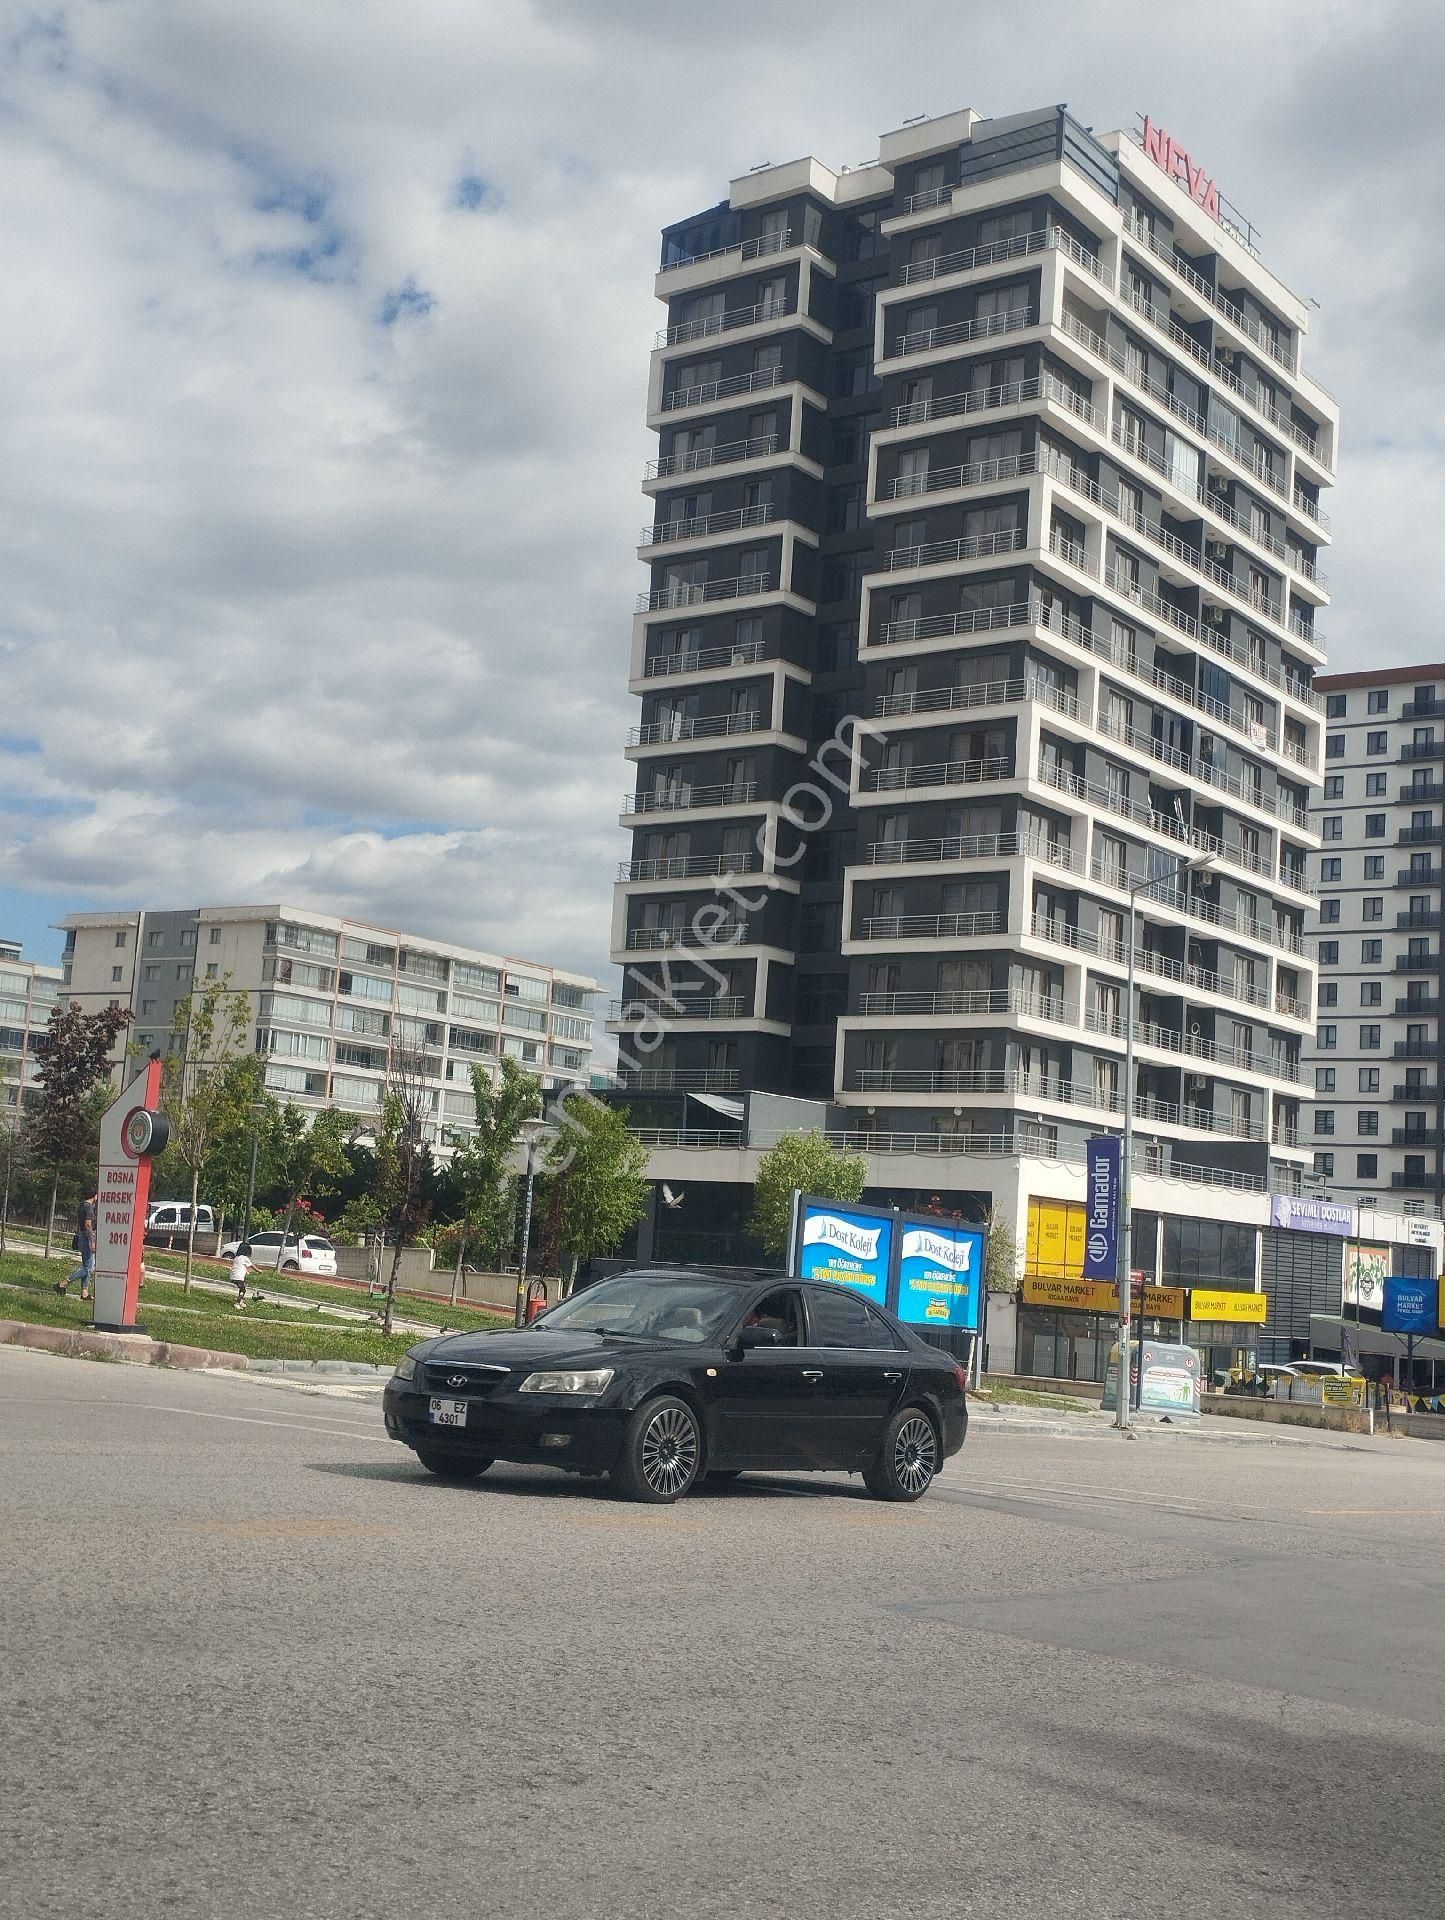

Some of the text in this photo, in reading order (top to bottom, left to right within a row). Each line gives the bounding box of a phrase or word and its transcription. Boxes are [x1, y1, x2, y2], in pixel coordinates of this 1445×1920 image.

[1143, 115, 1220, 222] NEVA
[107, 1171, 134, 1184] BOSNA
[100, 1191, 133, 1204] HERSEK
[1089, 1155, 1110, 1229] Gamador
[105, 1212, 130, 1225] PARKI
[1321, 1206, 1352, 1224] DOSTLAR
[109, 1231, 128, 1246] 2018
[829, 1223, 873, 1258] Dost Koleji
[924, 1238, 965, 1270] Dost Koleji
[1032, 1281, 1096, 1296] BULVAR MARKET
[1143, 1293, 1178, 1304] MARKET
[1398, 1294, 1423, 1303] BULVAR
[1397, 1302, 1424, 1310] MARKET
[431, 1400, 466, 1414] 06 EZ
[439, 1413, 459, 1424] 4301
